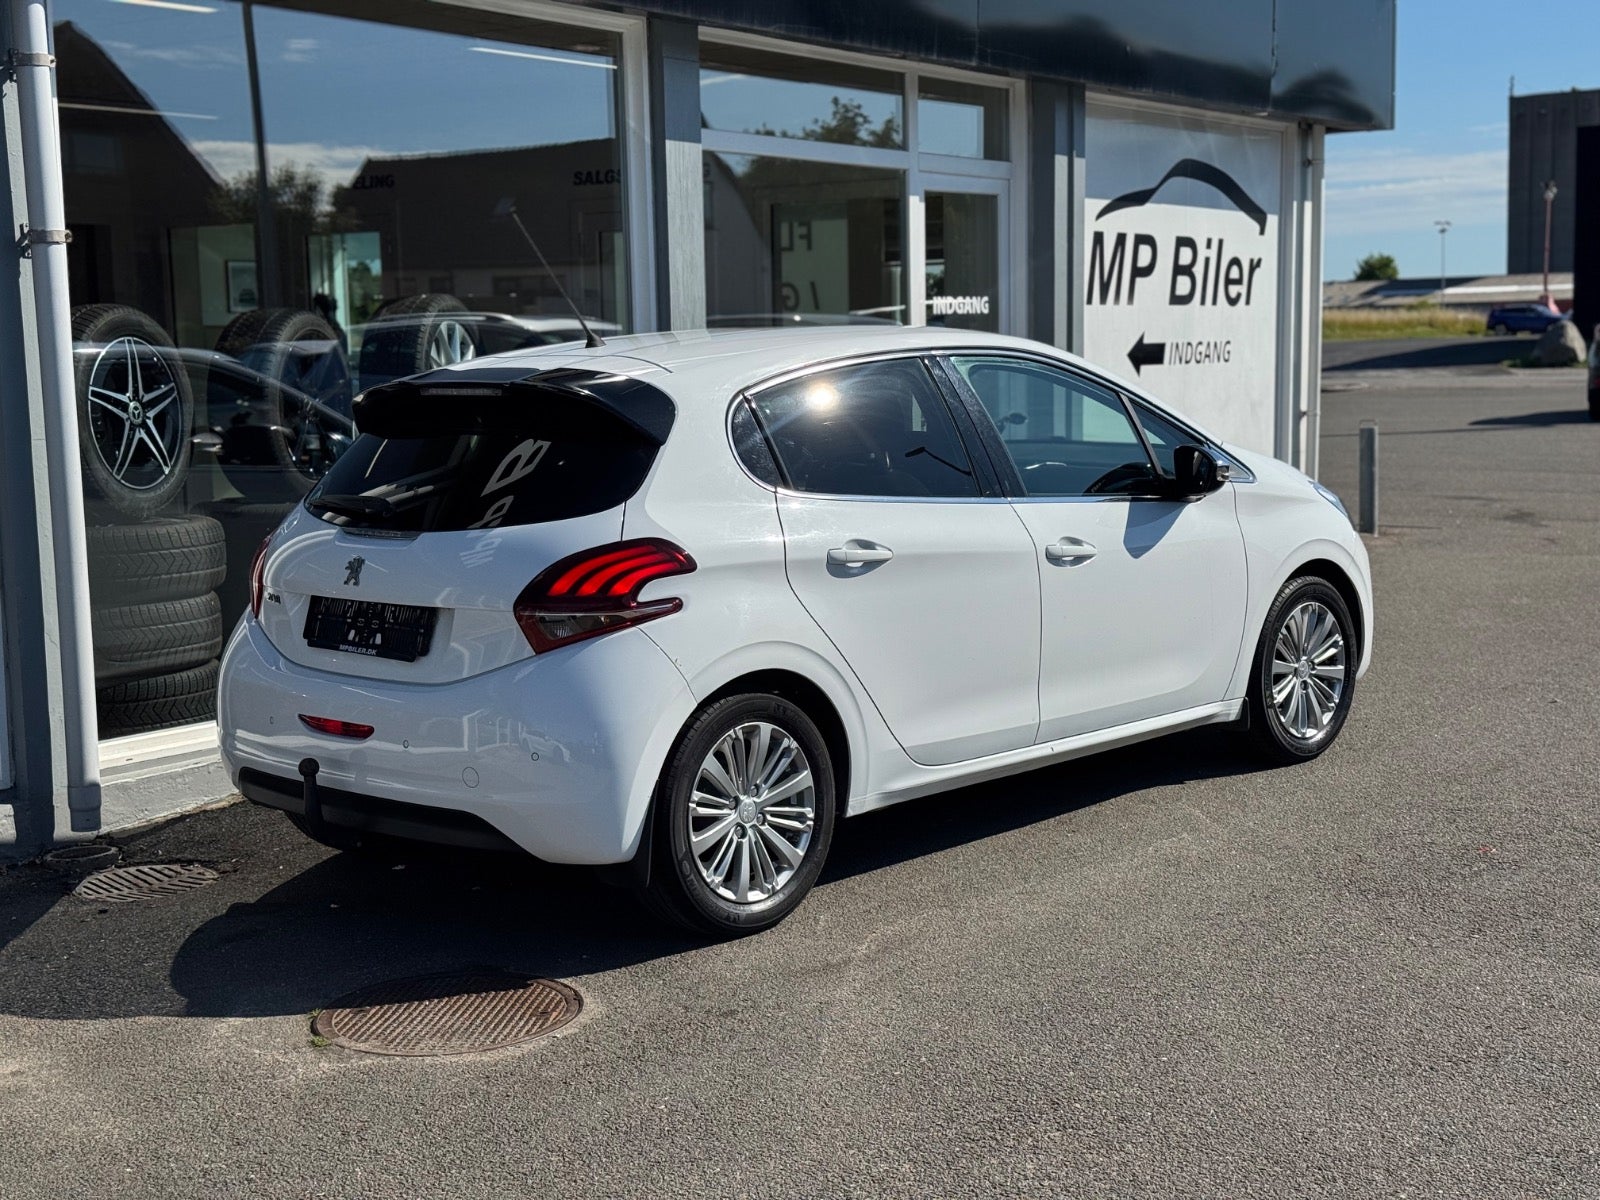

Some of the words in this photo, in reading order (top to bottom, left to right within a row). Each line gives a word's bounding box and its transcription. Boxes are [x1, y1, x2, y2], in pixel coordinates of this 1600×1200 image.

[1086, 231, 1158, 306] MP
[1168, 236, 1262, 307] Biler
[932, 295, 990, 315] INDGANG
[1168, 340, 1231, 365] INDGANG
